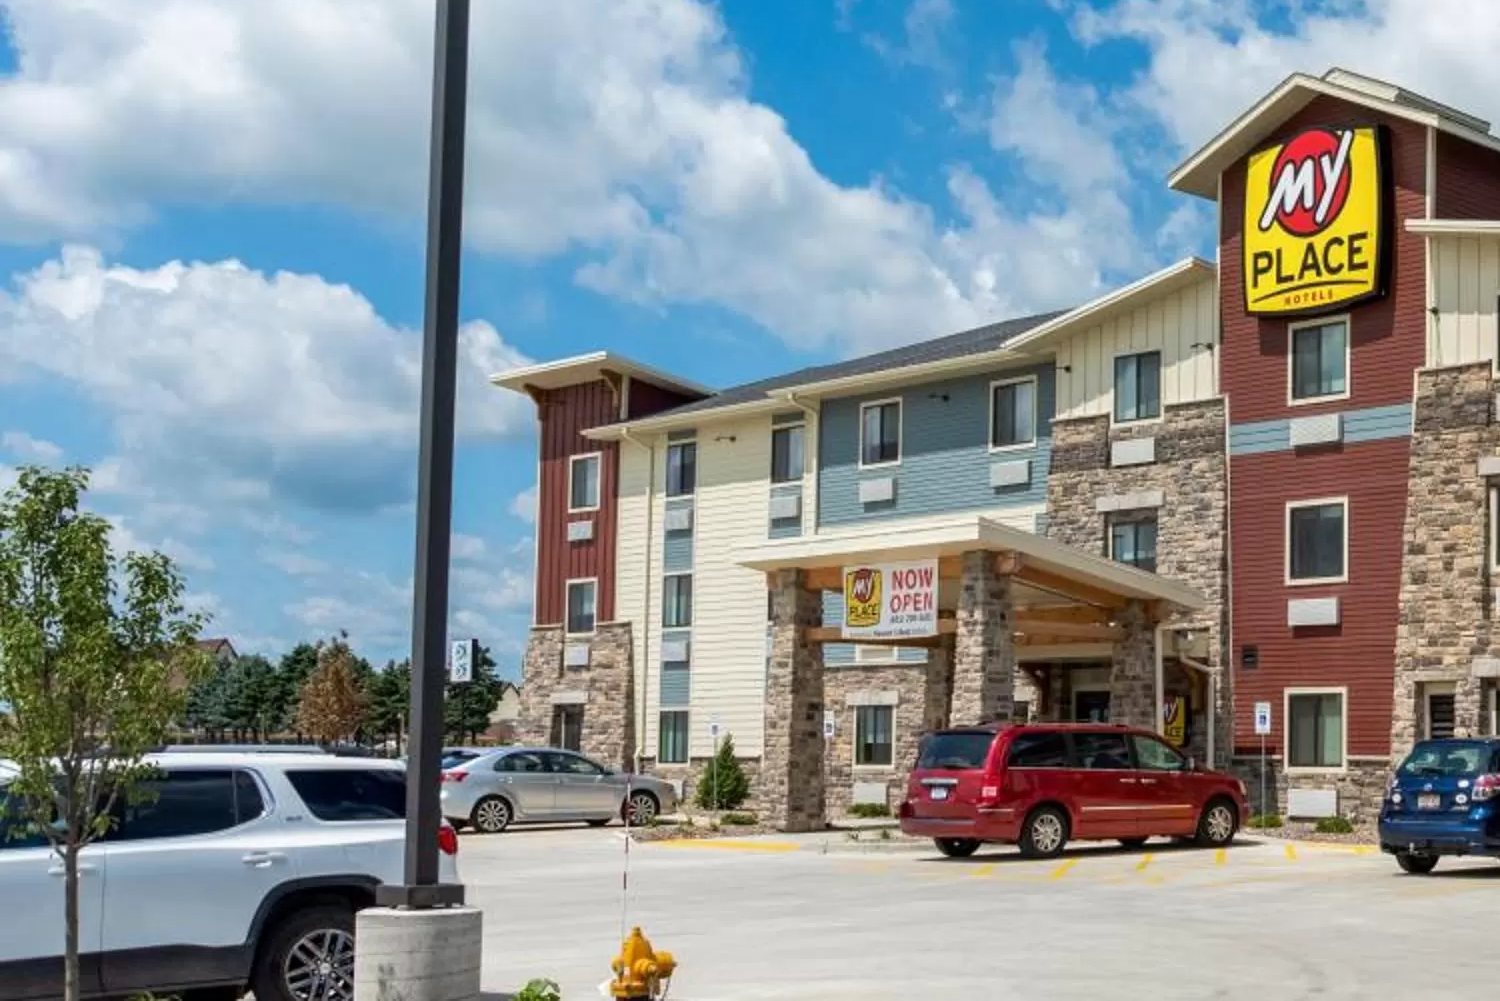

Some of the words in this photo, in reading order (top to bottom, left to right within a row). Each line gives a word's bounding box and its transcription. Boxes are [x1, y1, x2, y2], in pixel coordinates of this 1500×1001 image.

[1252, 232, 1369, 289] PLACE
[1284, 289, 1334, 306] HOTELS
[891, 567, 933, 591] NOW
[849, 604, 878, 616] PLACE
[890, 592, 933, 614] OPEN
